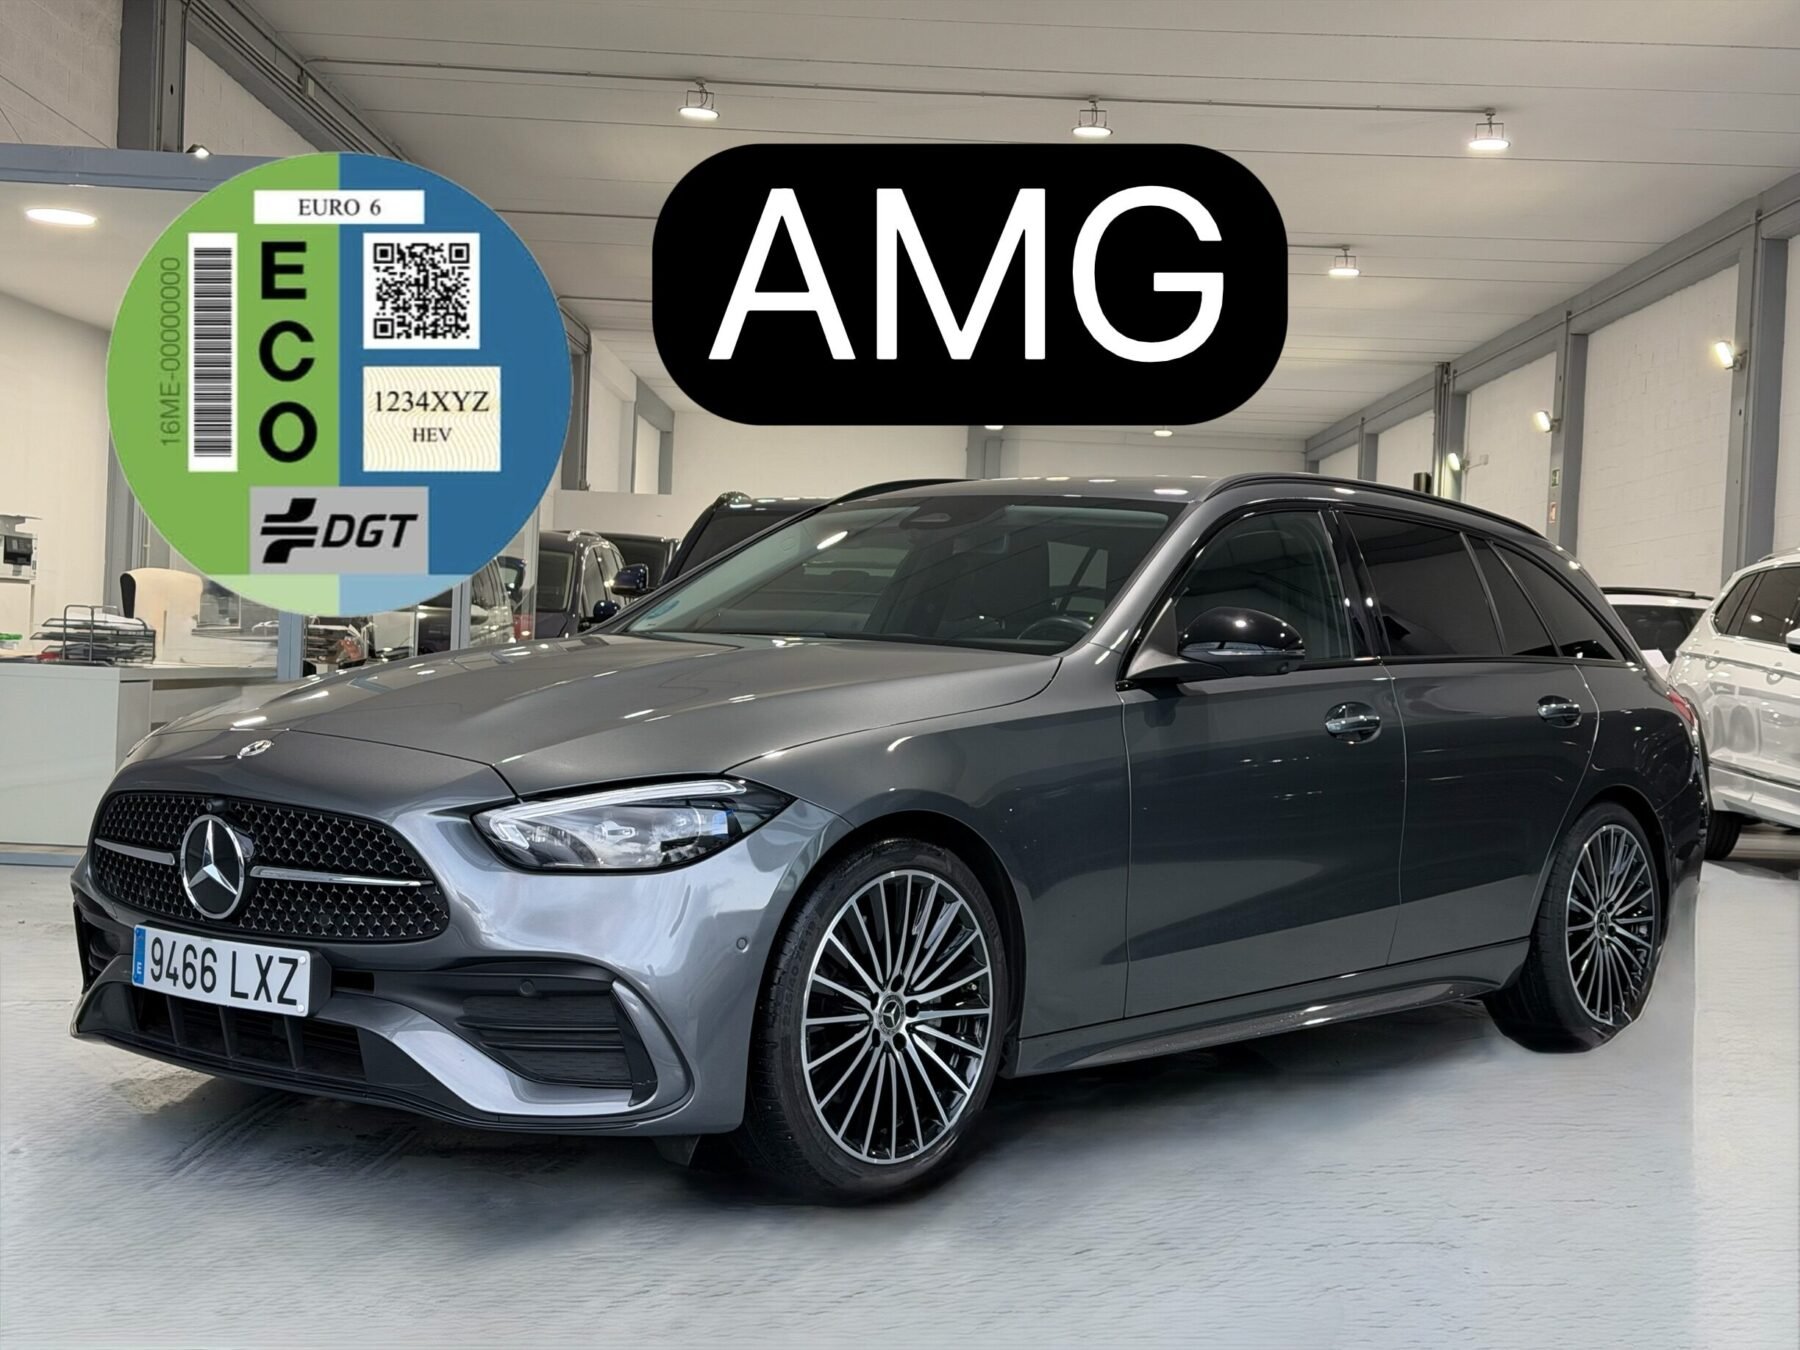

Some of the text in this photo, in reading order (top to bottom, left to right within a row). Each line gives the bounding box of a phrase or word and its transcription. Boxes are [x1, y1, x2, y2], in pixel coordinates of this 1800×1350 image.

[136, 936, 299, 1006] E 9466 LXZ
